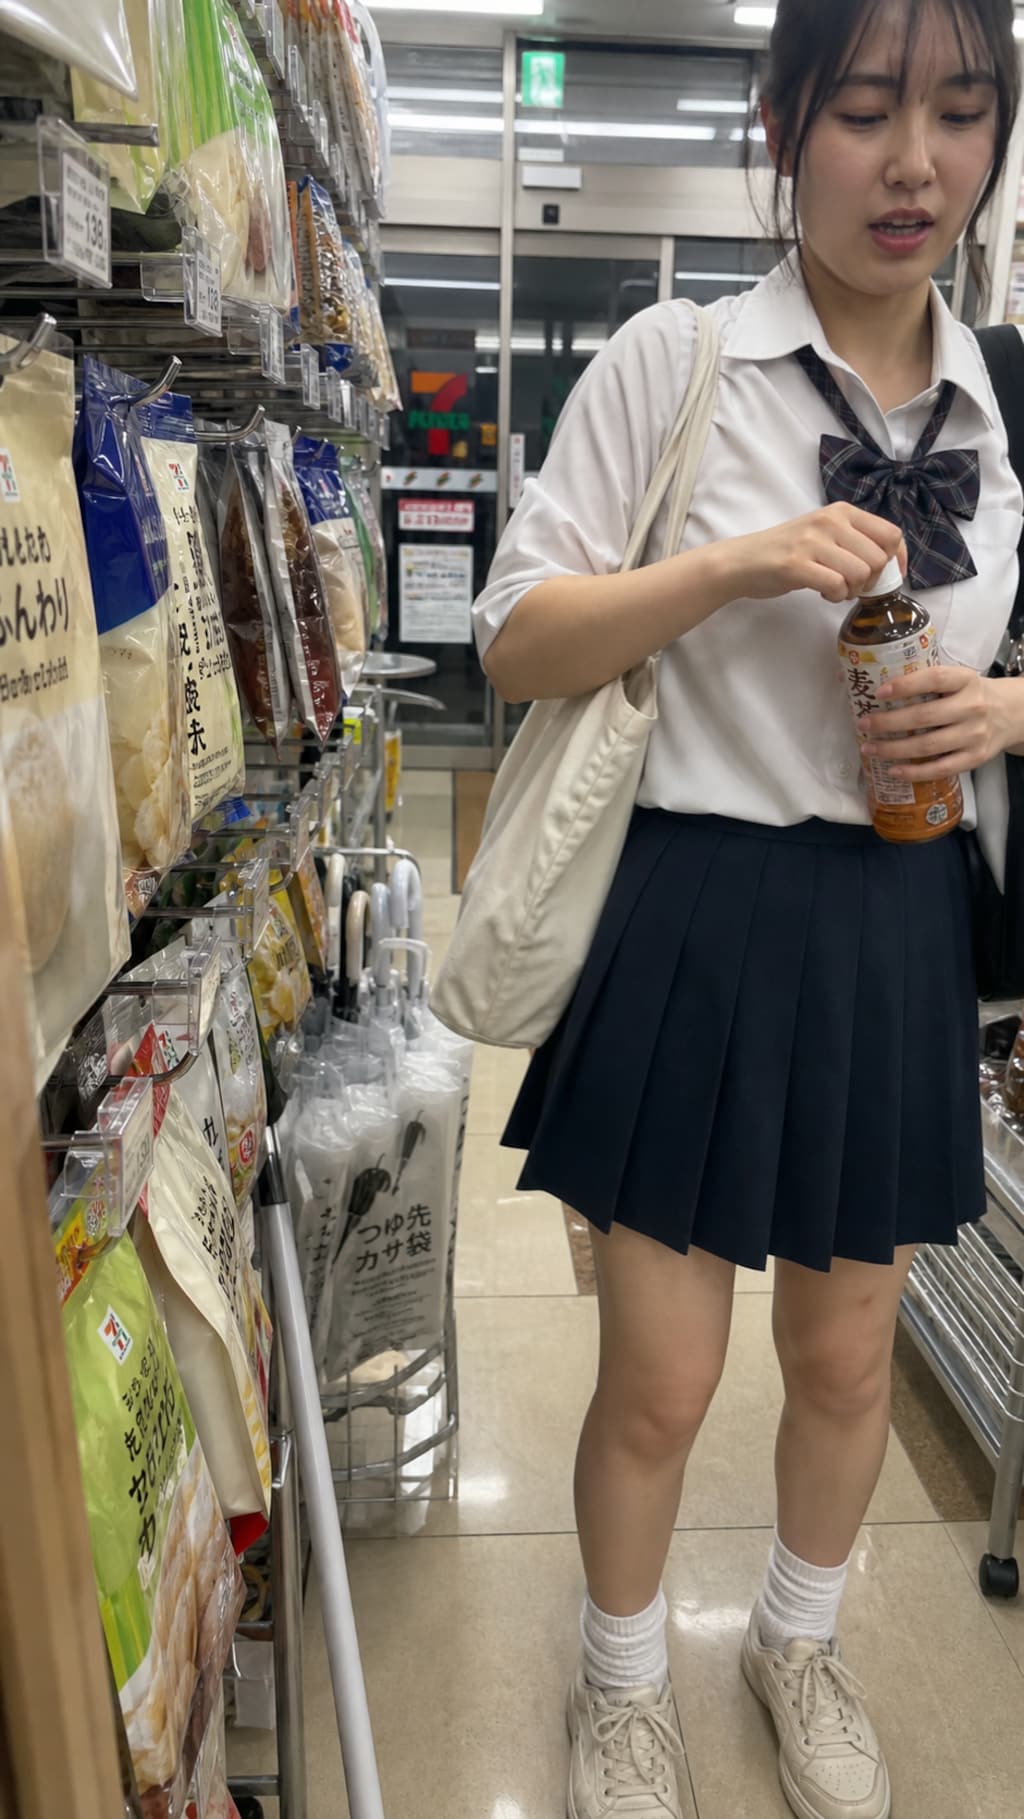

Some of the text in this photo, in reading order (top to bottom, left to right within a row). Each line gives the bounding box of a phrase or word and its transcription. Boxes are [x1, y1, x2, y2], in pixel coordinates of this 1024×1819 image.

[357, 1203, 432, 1245] つゆ先
[355, 1231, 432, 1273] カサ袋
